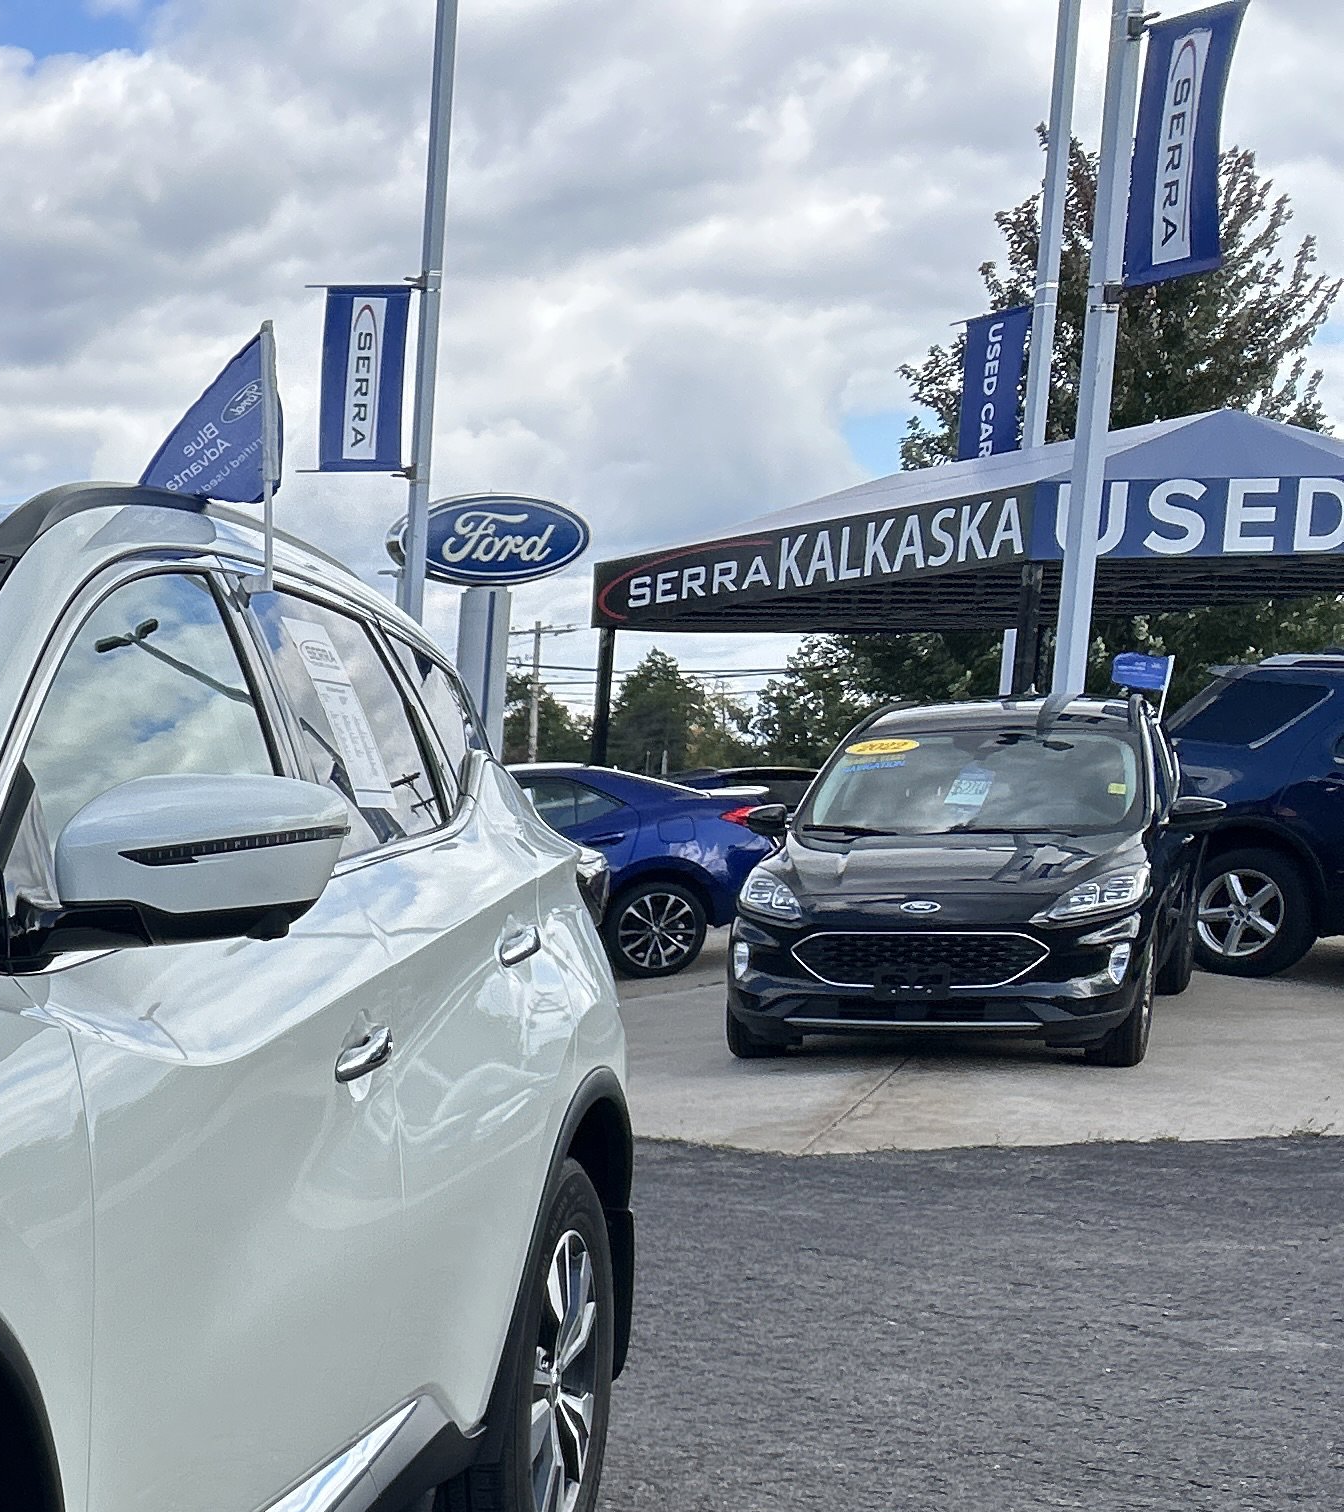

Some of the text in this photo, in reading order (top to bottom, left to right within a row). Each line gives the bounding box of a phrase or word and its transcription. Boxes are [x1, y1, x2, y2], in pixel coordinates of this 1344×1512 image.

[1161, 76, 1191, 247] SERRA
[350, 331, 373, 448] SERRA
[983, 322, 1004, 396] USED
[442, 511, 556, 563] Ford
[628, 497, 1024, 608] SERRA KALKASKA
[1055, 477, 1344, 555] USED
